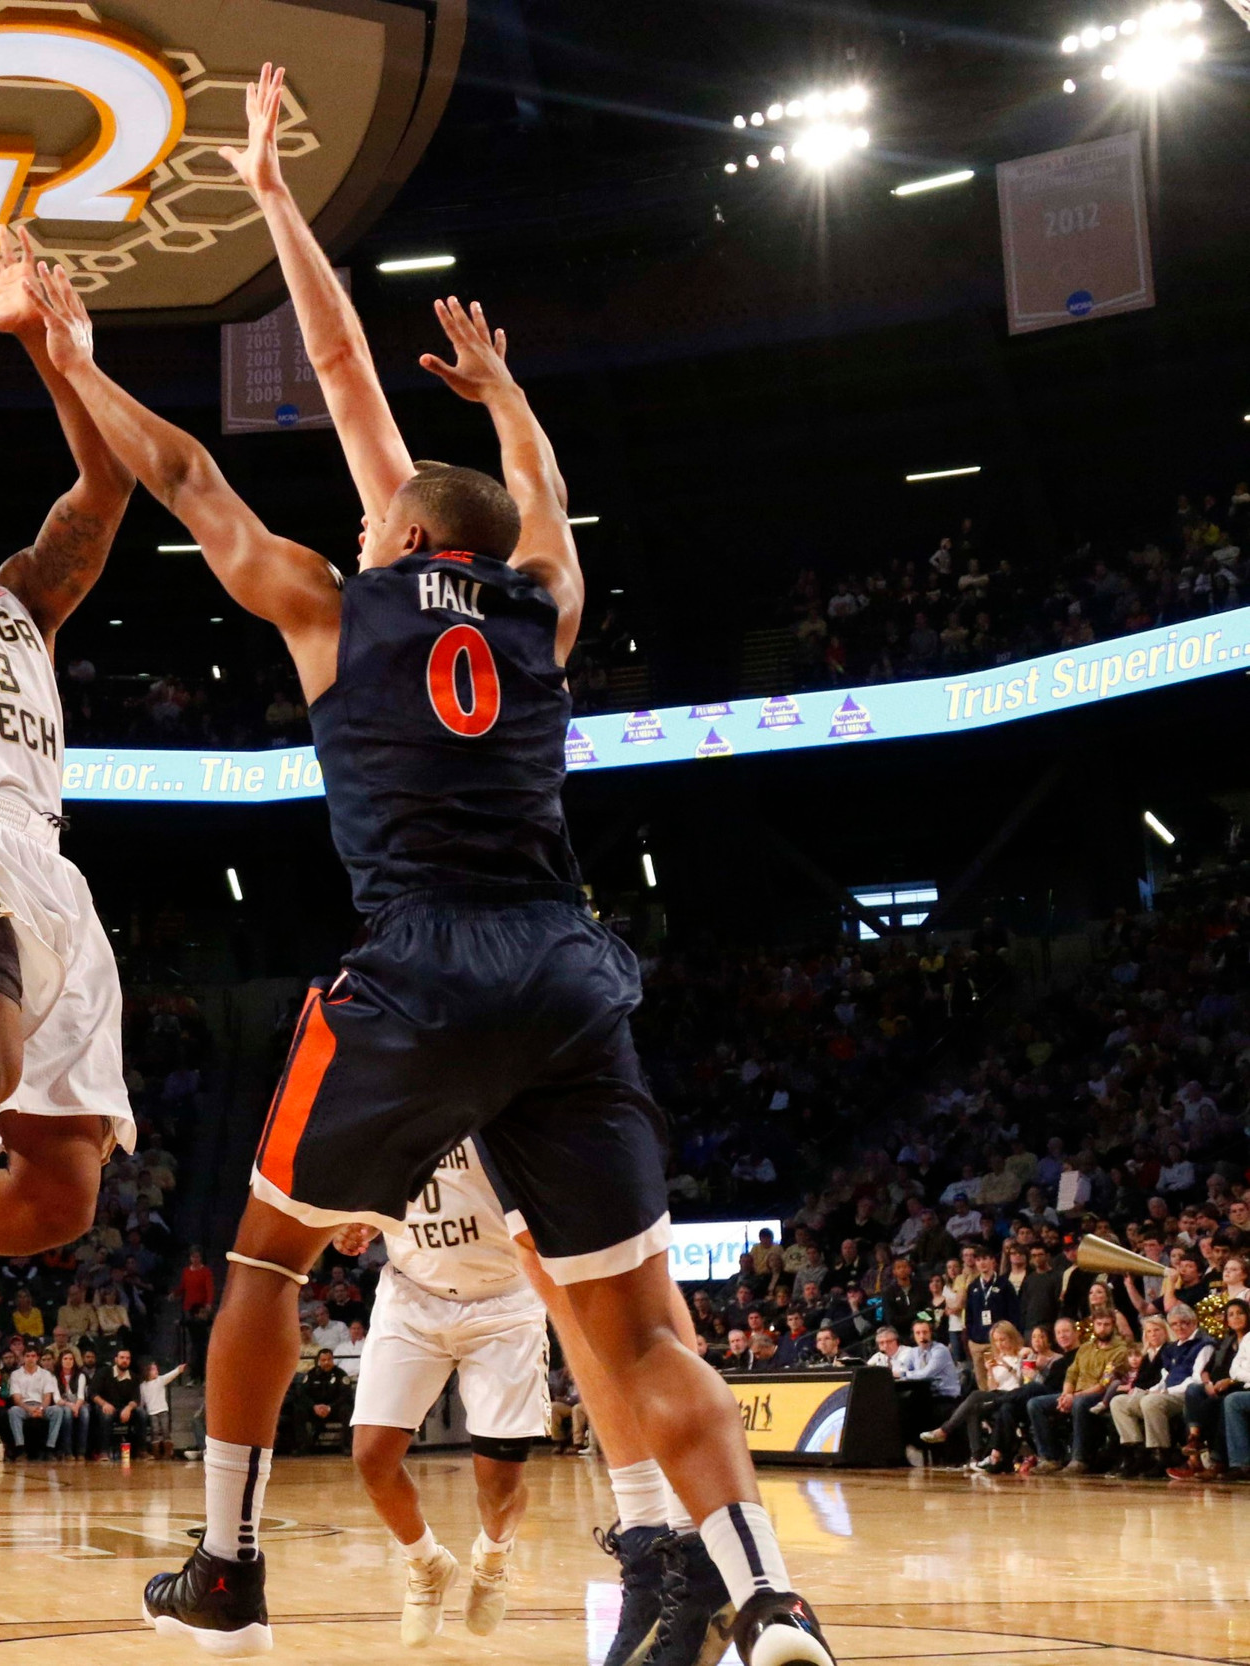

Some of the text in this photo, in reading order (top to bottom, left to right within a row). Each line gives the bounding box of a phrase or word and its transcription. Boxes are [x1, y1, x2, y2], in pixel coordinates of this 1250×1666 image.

[1044, 202, 1100, 238] 2012
[246, 350, 281, 366] 2007
[246, 368, 282, 384] 2008
[246, 386, 282, 403] 2009
[418, 571, 485, 620] HALL
[426, 623, 501, 738] 0
[943, 630, 1250, 722] Trust Superior...
[764, 703, 796, 716] Superior
[835, 711, 867, 725] Superior
[626, 718, 658, 731] Superior
[697, 744, 730, 757] Superior
[199, 756, 265, 793] The
[423, 1178, 442, 1214] 0
[408, 1215, 480, 1249] TECH
